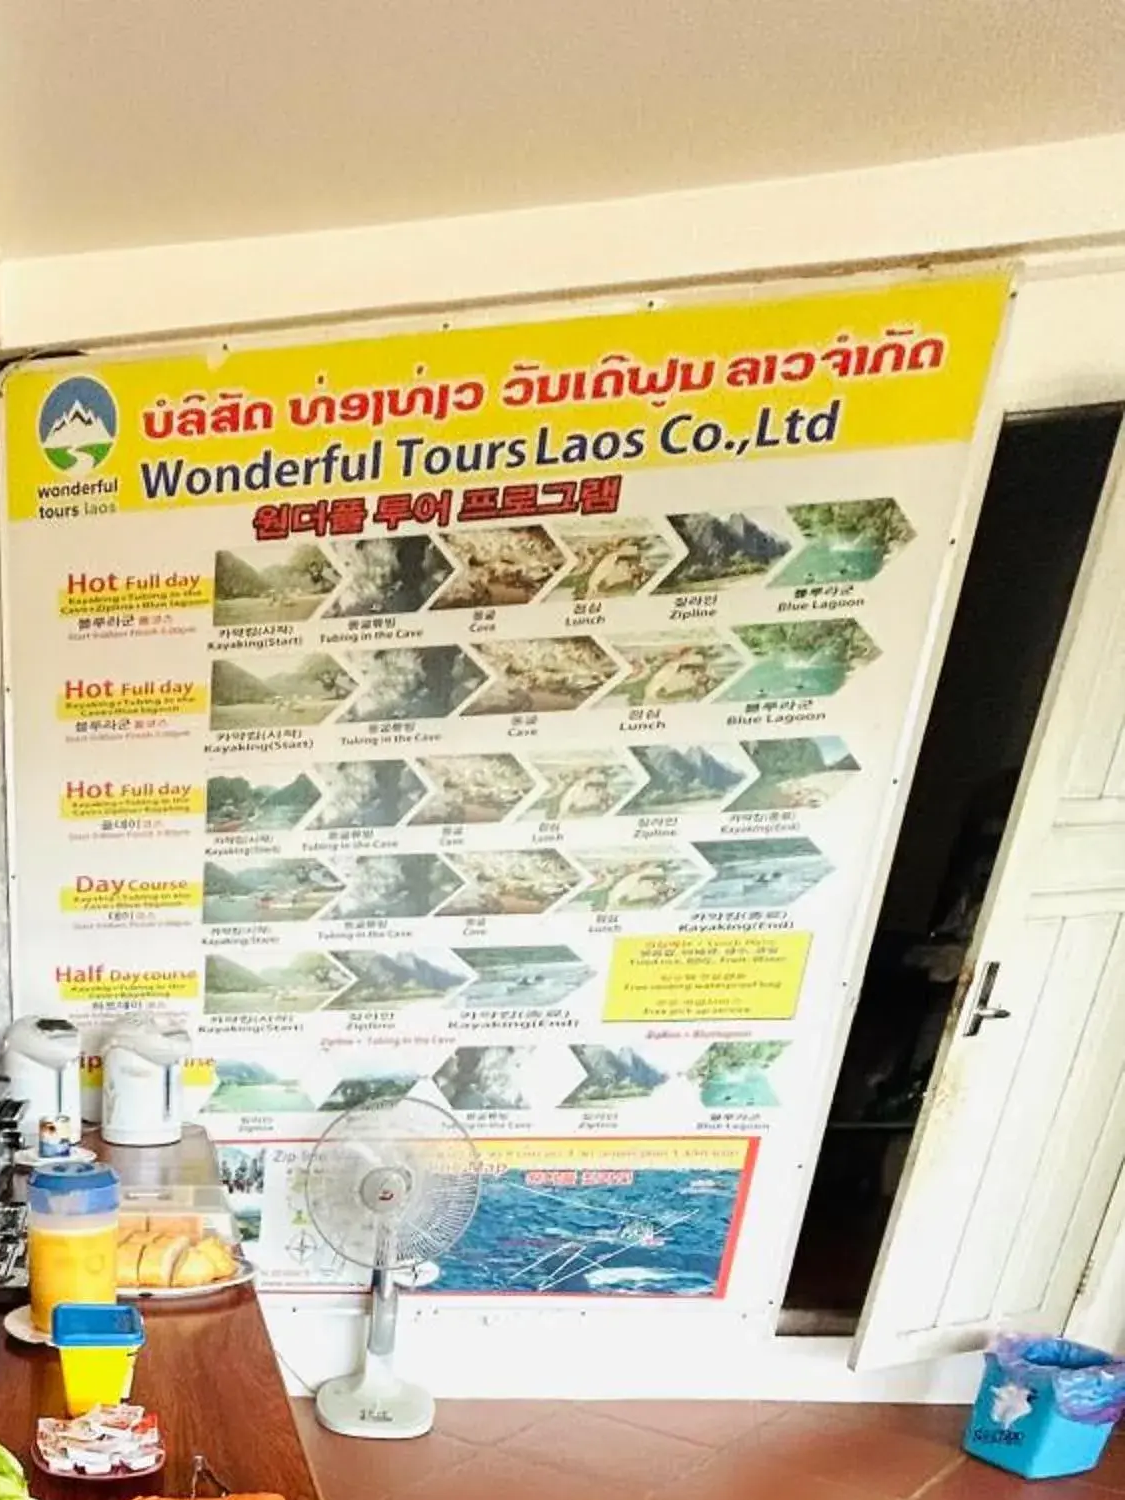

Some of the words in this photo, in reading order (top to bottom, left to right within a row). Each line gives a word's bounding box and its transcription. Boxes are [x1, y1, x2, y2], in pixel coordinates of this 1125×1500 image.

[141, 441, 381, 499] Wonderful
[397, 437, 527, 477] Tours
[537, 428, 644, 464] Laos
[660, 400, 841, 456] Co.,Ltd
[37, 479, 118, 500] wonderful
[39, 505, 79, 519] tours
[84, 501, 116, 516] laos
[253, 500, 368, 541] 원더풀
[373, 491, 452, 531] 투어
[457, 474, 622, 522] 프로그램
[67, 572, 119, 594] Hot
[126, 574, 160, 590] Full
[165, 572, 200, 590] day
[669, 608, 717, 621] Zipline
[777, 601, 810, 612] Blue
[813, 598, 865, 610] Lagoon
[565, 614, 606, 627] Lunch
[65, 680, 113, 699] Hot
[121, 681, 154, 696] Full
[160, 680, 194, 697] day
[66, 781, 113, 799] Hot
[121, 783, 153, 797] Full
[158, 782, 192, 800] day
[76, 876, 125, 895] Day
[56, 965, 103, 982] Half
